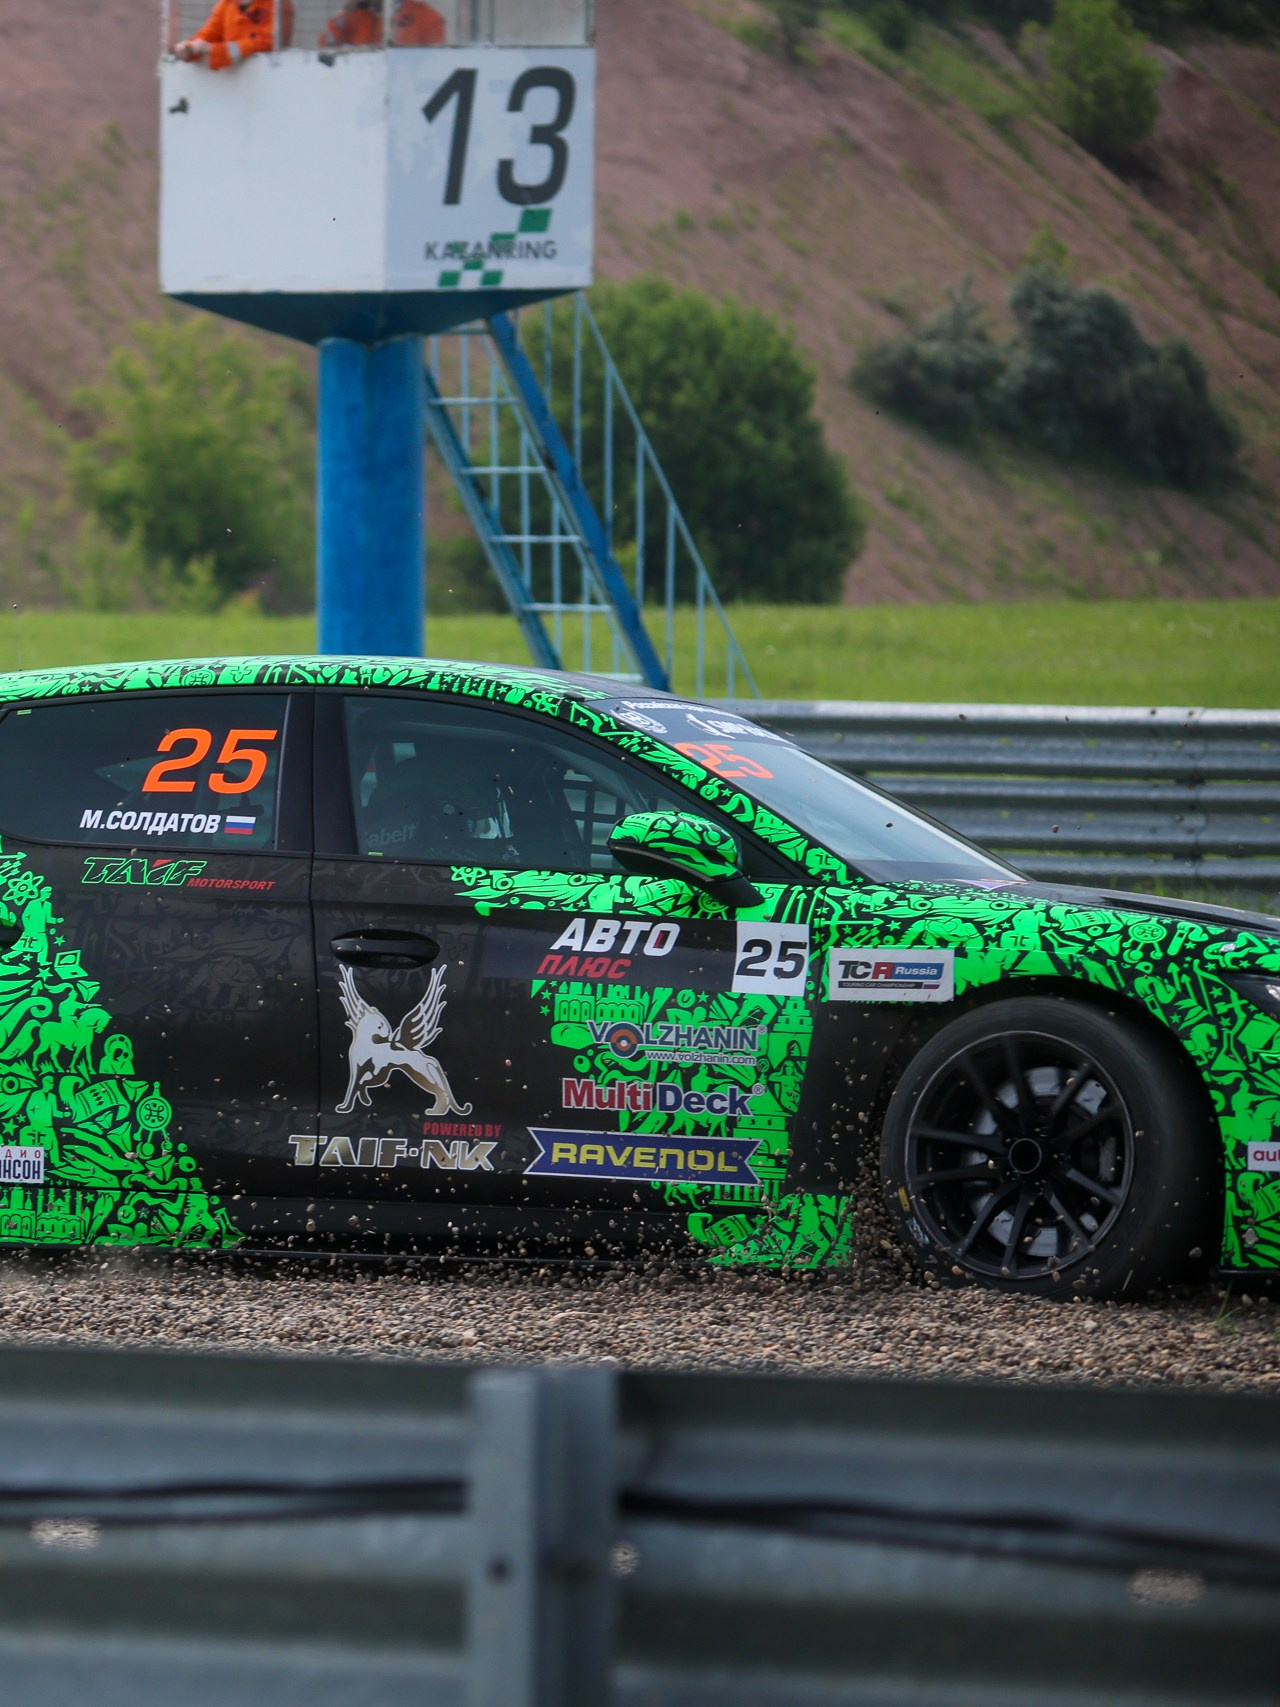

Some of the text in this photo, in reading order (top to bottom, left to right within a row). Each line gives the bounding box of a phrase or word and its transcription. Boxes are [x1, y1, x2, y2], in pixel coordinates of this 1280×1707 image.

[422, 66, 577, 206] 13
[142, 727, 278, 794] 25
[674, 742, 775, 779] 25
[80, 809, 221, 835] М.СОЛДАТОВ
[186, 877, 276, 890] MOTORSPORT
[550, 917, 681, 957] АВТО
[536, 954, 632, 979] ПЛЮС
[735, 938, 808, 980] 25
[838, 960, 938, 979] TCR Russia
[645, 1050, 757, 1066] www.volzhanin.com
[423, 1122, 502, 1137] POWERED BY
[551, 1142, 738, 1172] RAVENOL
